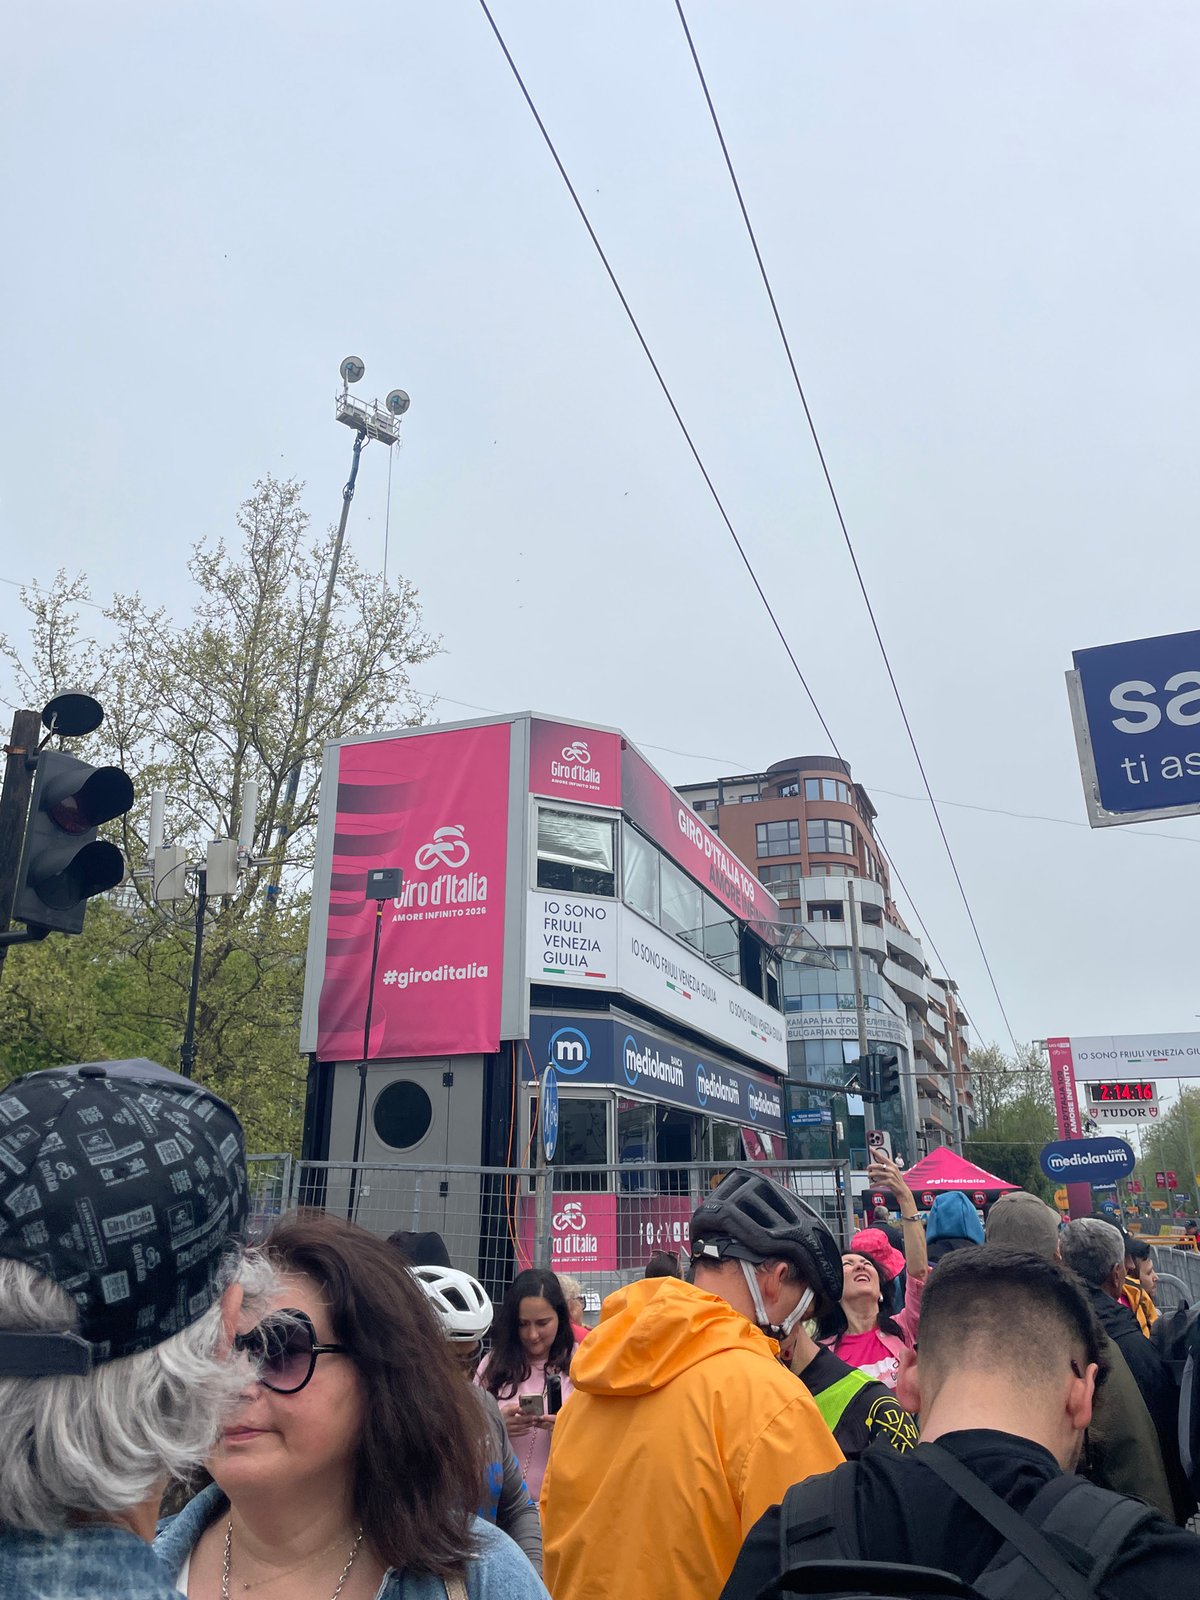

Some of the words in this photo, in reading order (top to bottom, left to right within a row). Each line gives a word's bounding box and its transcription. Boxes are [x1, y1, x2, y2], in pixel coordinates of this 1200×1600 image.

[1110, 671, 1200, 734] sa
[551, 761, 570, 779] Giro
[571, 765, 600, 784] d'Italia
[1121, 754, 1149, 785] ti
[1161, 752, 1200, 780] as
[678, 809, 703, 850] GIRO
[704, 835, 741, 889] D'ITALIA
[740, 873, 755, 902] 109
[430, 872, 488, 905] d'Italia
[709, 864, 741, 908] AMORE
[392, 912, 423, 922] AMORE
[425, 909, 464, 919] INFINITO
[465, 906, 486, 916] 2026
[544, 901, 560, 914] IO
[564, 903, 606, 920] SONO
[544, 917, 582, 933] FRIULI
[543, 934, 602, 952] VENEZIA
[543, 951, 589, 968] GIULIA
[631, 937, 640, 957] IO
[640, 944, 660, 969] SONO
[661, 956, 677, 980] FRIULI
[678, 967, 701, 996] VENEZIA
[701, 982, 717, 1004] GIULIA
[383, 963, 488, 988] #giroditalia
[787, 1017, 819, 1026] КАМАРА
[822, 1017, 833, 1025] НА
[787, 1028, 836, 1038] BULGARIAN
[839, 1028, 893, 1039] CONRUCTION
[556, 1040, 583, 1061] m
[1078, 1052, 1089, 1061] IO
[1090, 1051, 1117, 1060] SONO
[1120, 1050, 1145, 1059] FRIULI
[1146, 1049, 1185, 1057] VENEZIA
[626, 1046, 684, 1088] mediolanum
[697, 1072, 740, 1105] mediolanum
[1062, 1064, 1073, 1101] INFINITO
[1100, 1083, 1152, 1100] 2:14:16
[749, 1090, 781, 1118] mediolanum
[1101, 1108, 1147, 1118] TUDOR
[1067, 1101, 1078, 1134] AMORE
[1051, 1152, 1127, 1168] mediolanum
[552, 1236, 562, 1254] ro
[564, 1233, 598, 1254] d'Italia
